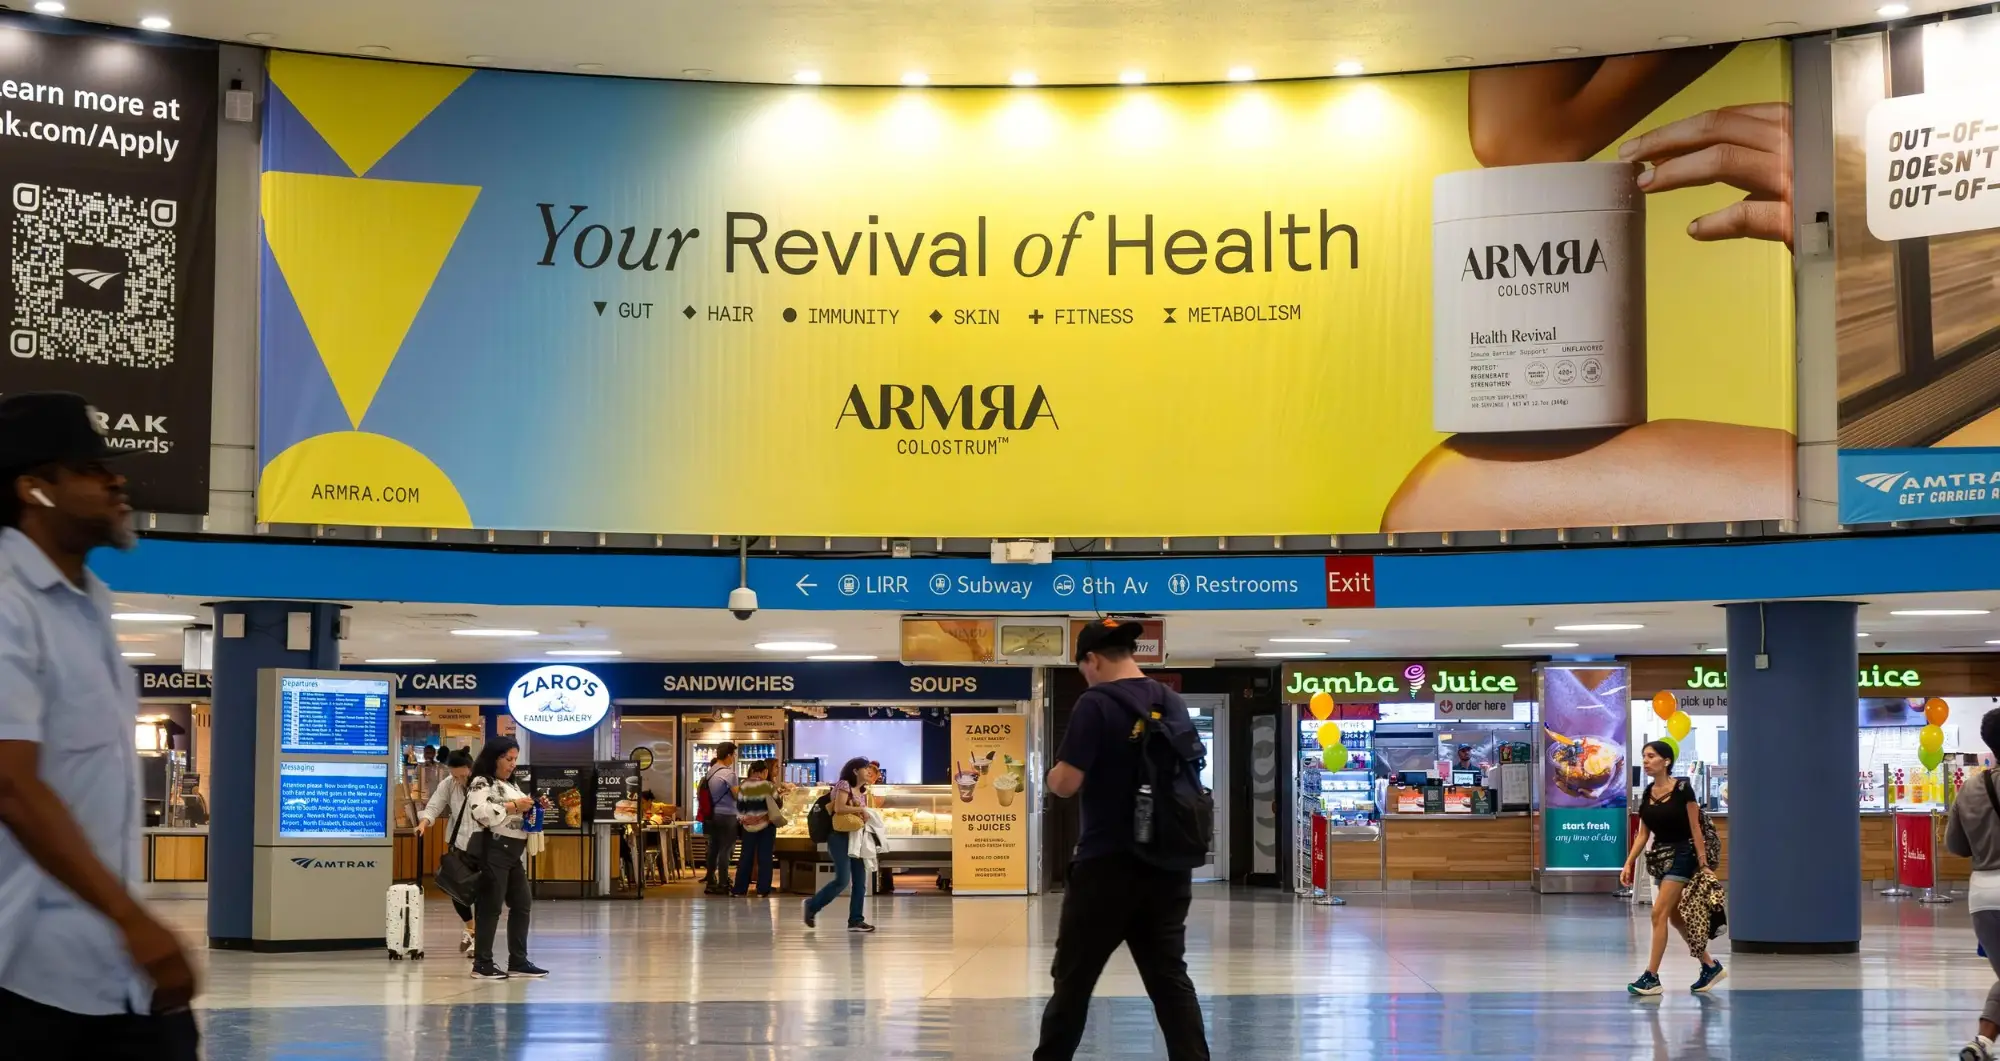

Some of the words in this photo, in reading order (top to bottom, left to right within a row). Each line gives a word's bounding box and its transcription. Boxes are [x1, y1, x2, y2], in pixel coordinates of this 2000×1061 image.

[74, 89, 144, 116] more
[153, 99, 180, 121] at
[0, 110, 180, 162] k.com/Apply
[1888, 145, 2000, 182] DOESN'T
[536, 203, 700, 272] Your
[726, 211, 986, 278] Revival
[1014, 210, 1095, 278] of
[1108, 208, 1359, 276] Health
[1498, 281, 1570, 297] COLOSTRUM
[619, 302, 653, 319] GUT
[708, 305, 754, 322] HAIR
[808, 307, 900, 325] IMMUNITY
[954, 308, 1000, 325] SKIN
[1055, 308, 1134, 325] FITNESS
[1189, 304, 1301, 323] METABOLISM
[1470, 330, 1507, 345] Health
[1511, 327, 1557, 342] Revival
[1561, 344, 1604, 353] UNFLAVORED
[95, 411, 168, 434] RAK
[311, 484, 420, 503] ARMRA.COM
[1899, 492, 1925, 505] GET
[1930, 489, 1985, 503] CARRIED
[866, 575, 909, 594] LIRR
[957, 575, 1032, 599] Subway
[1082, 575, 1116, 595] 8th
[1123, 576, 1149, 595] Av
[1196, 574, 1299, 594] Restrooms
[1328, 571, 1373, 594] Exit
[282, 679, 319, 688] Departures
[412, 673, 478, 690] CAKES
[663, 675, 796, 692] SANDWICHES
[909, 676, 978, 693] SOUPS
[1286, 671, 1400, 694] Jamba
[1431, 670, 1520, 694] Juice
[1857, 664, 1922, 687] uice
[517, 674, 599, 699] ZARO'S
[1455, 700, 1482, 711] order
[1484, 700, 1507, 711] here
[1680, 695, 1700, 708] pick
[1702, 697, 1715, 708] up
[1717, 695, 1728, 706] he
[523, 714, 554, 723] FAMILY
[556, 714, 593, 723] BAKERY
[965, 724, 1012, 735] ZARO'S
[281, 763, 315, 773] Messaging
[597, 777, 604, 785] &
[605, 777, 621, 785] LOX
[961, 813, 1017, 822] SMOOTHIES
[1562, 822, 1586, 830] start
[1586, 821, 1610, 830] fresh
[968, 823, 974, 831] &
[976, 823, 1011, 831] JUICES
[1555, 835, 1571, 844] any
[1572, 834, 1590, 842] time
[1591, 833, 1601, 842] of
[1601, 833, 1617, 844] day
